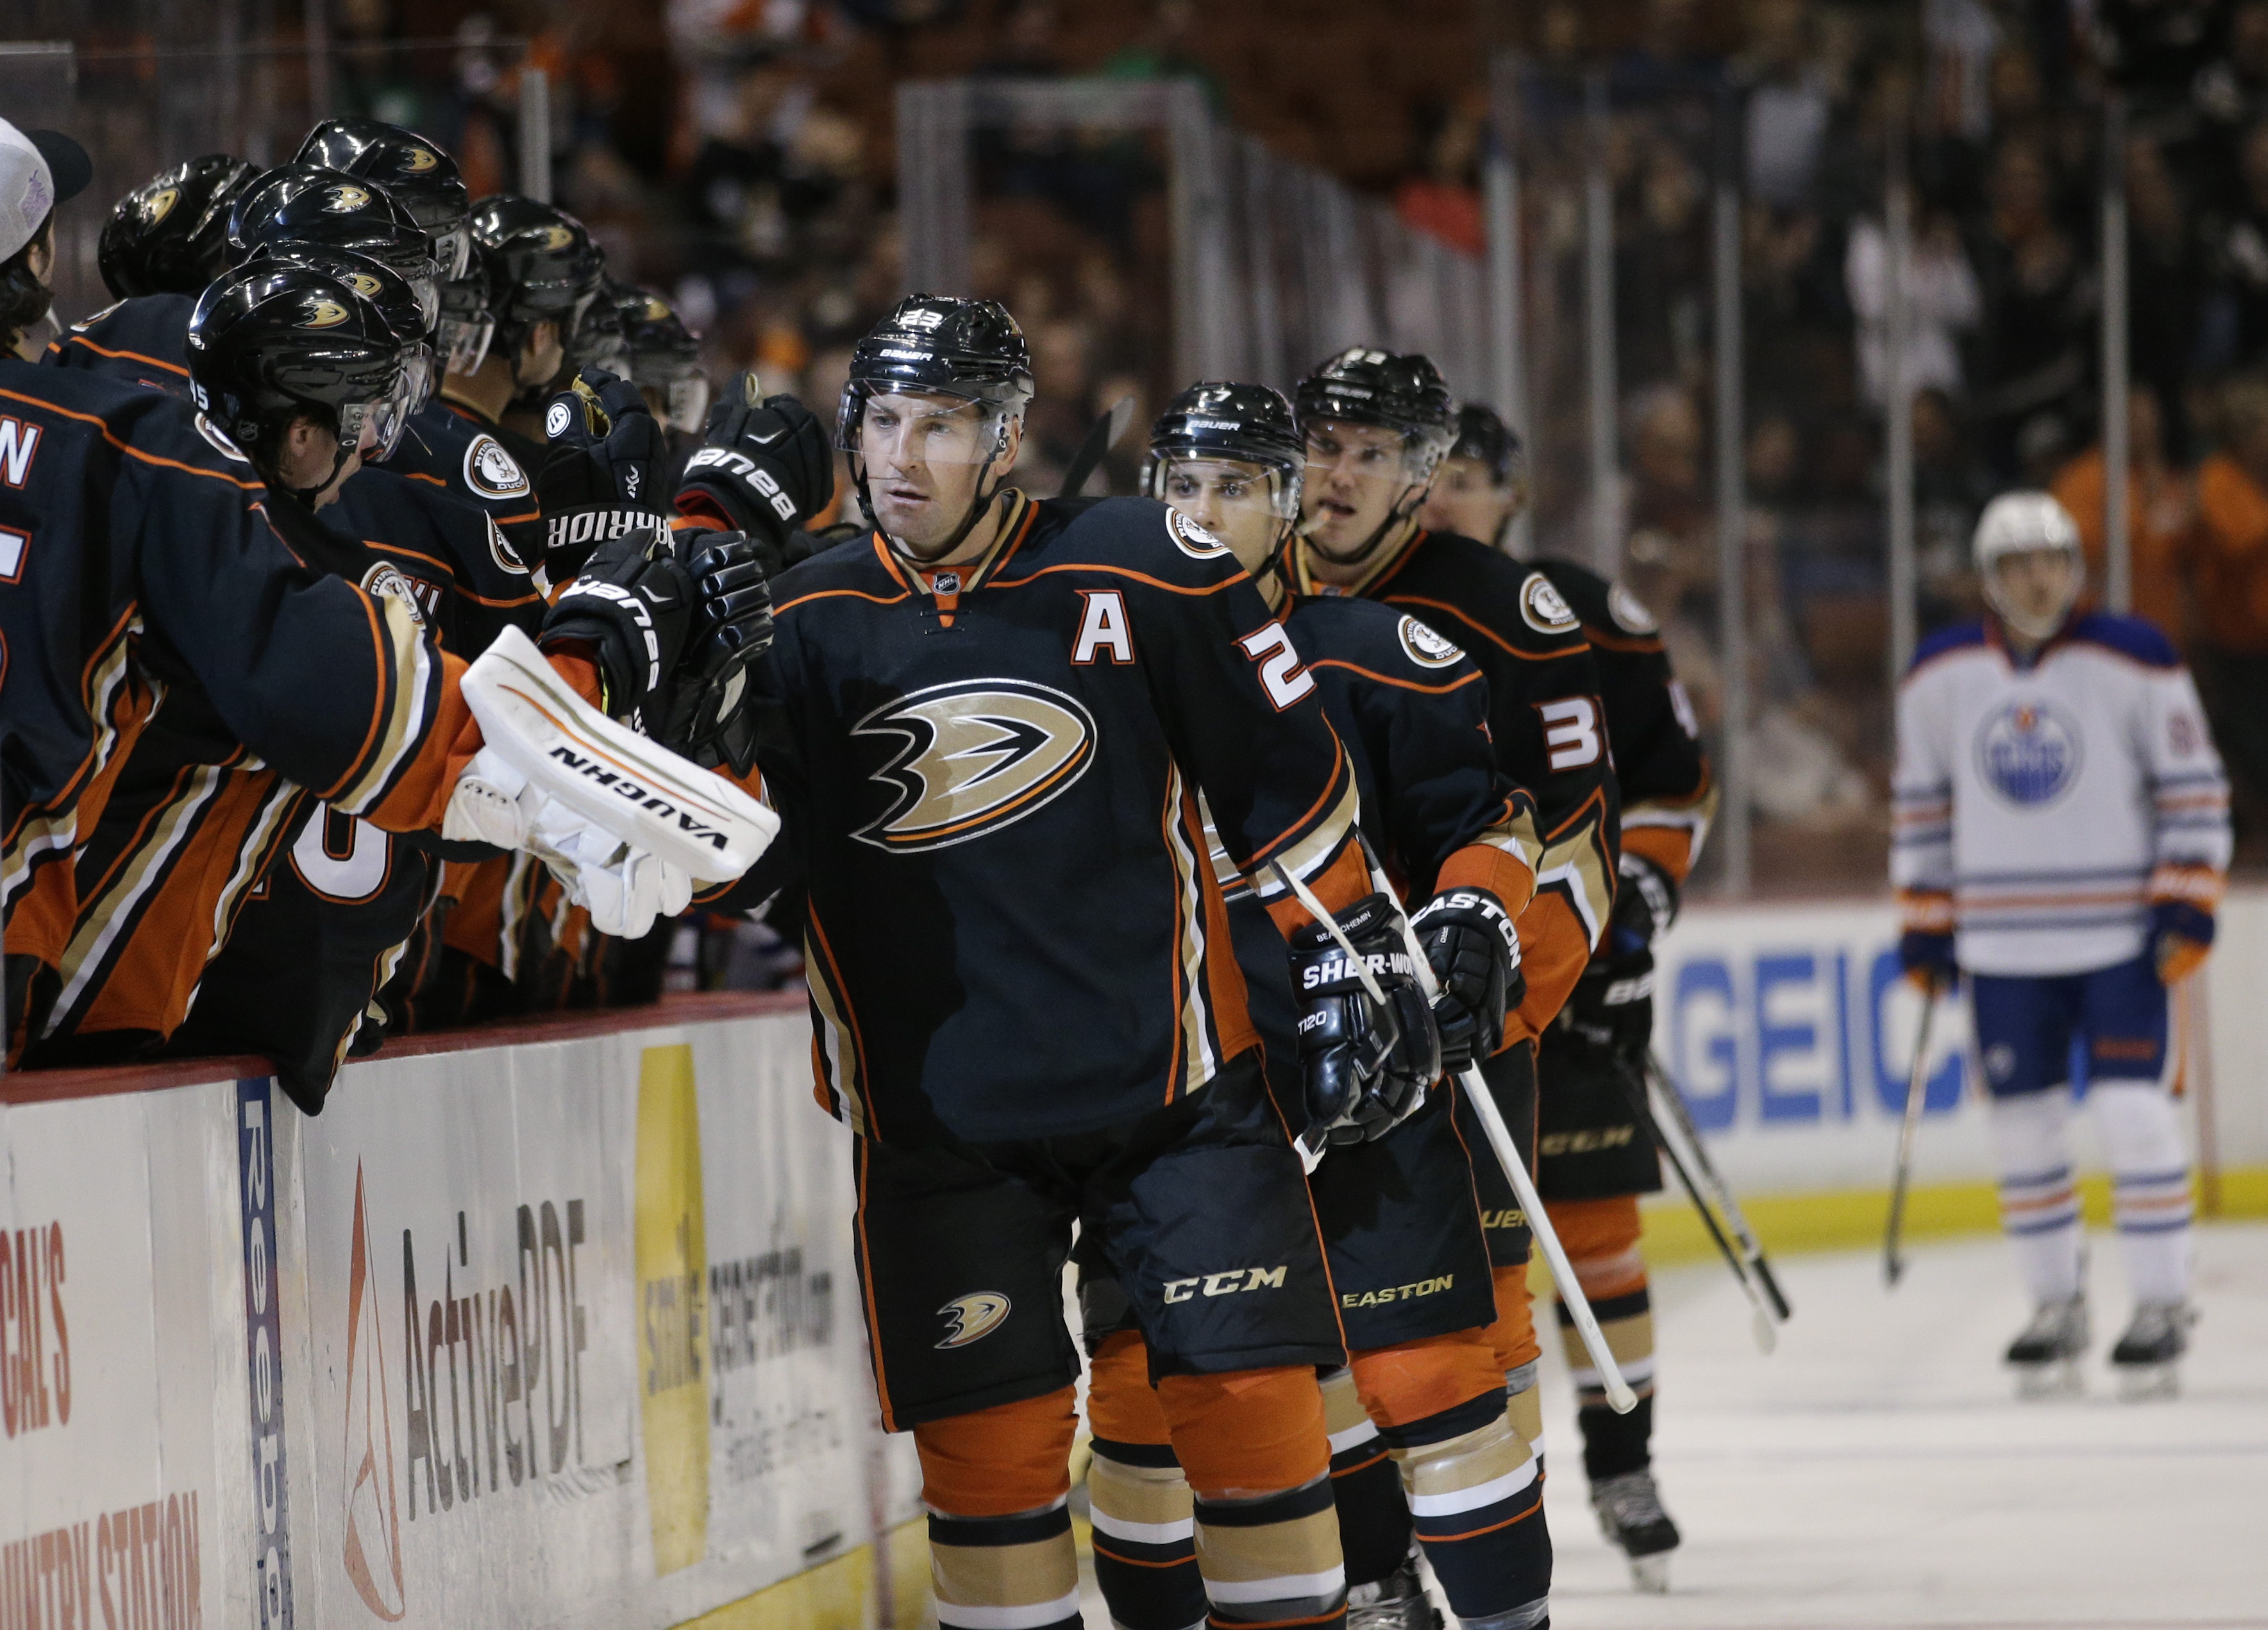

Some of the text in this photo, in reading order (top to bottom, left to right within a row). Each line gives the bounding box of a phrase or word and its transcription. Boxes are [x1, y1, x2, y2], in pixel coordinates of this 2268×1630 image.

[879, 349, 934, 361] BAUER
[1188, 420, 1241, 431] BAUER
[683, 448, 797, 521] BAUER
[937, 576, 955, 589] NHL
[1070, 589, 1135, 666] A
[1529, 694, 1616, 774] 3
[550, 746, 729, 852] VAUGHN
[1316, 911, 1372, 943] BEACHEMIN
[1409, 893, 1522, 970] EASTON
[1303, 952, 1413, 990] SHER-WO
[1672, 949, 1963, 1134] GEIC
[1163, 1265, 1288, 1304] CCM
[1341, 1274, 1453, 1309] EASTON
[403, 1198, 587, 1522] ActivePDF
